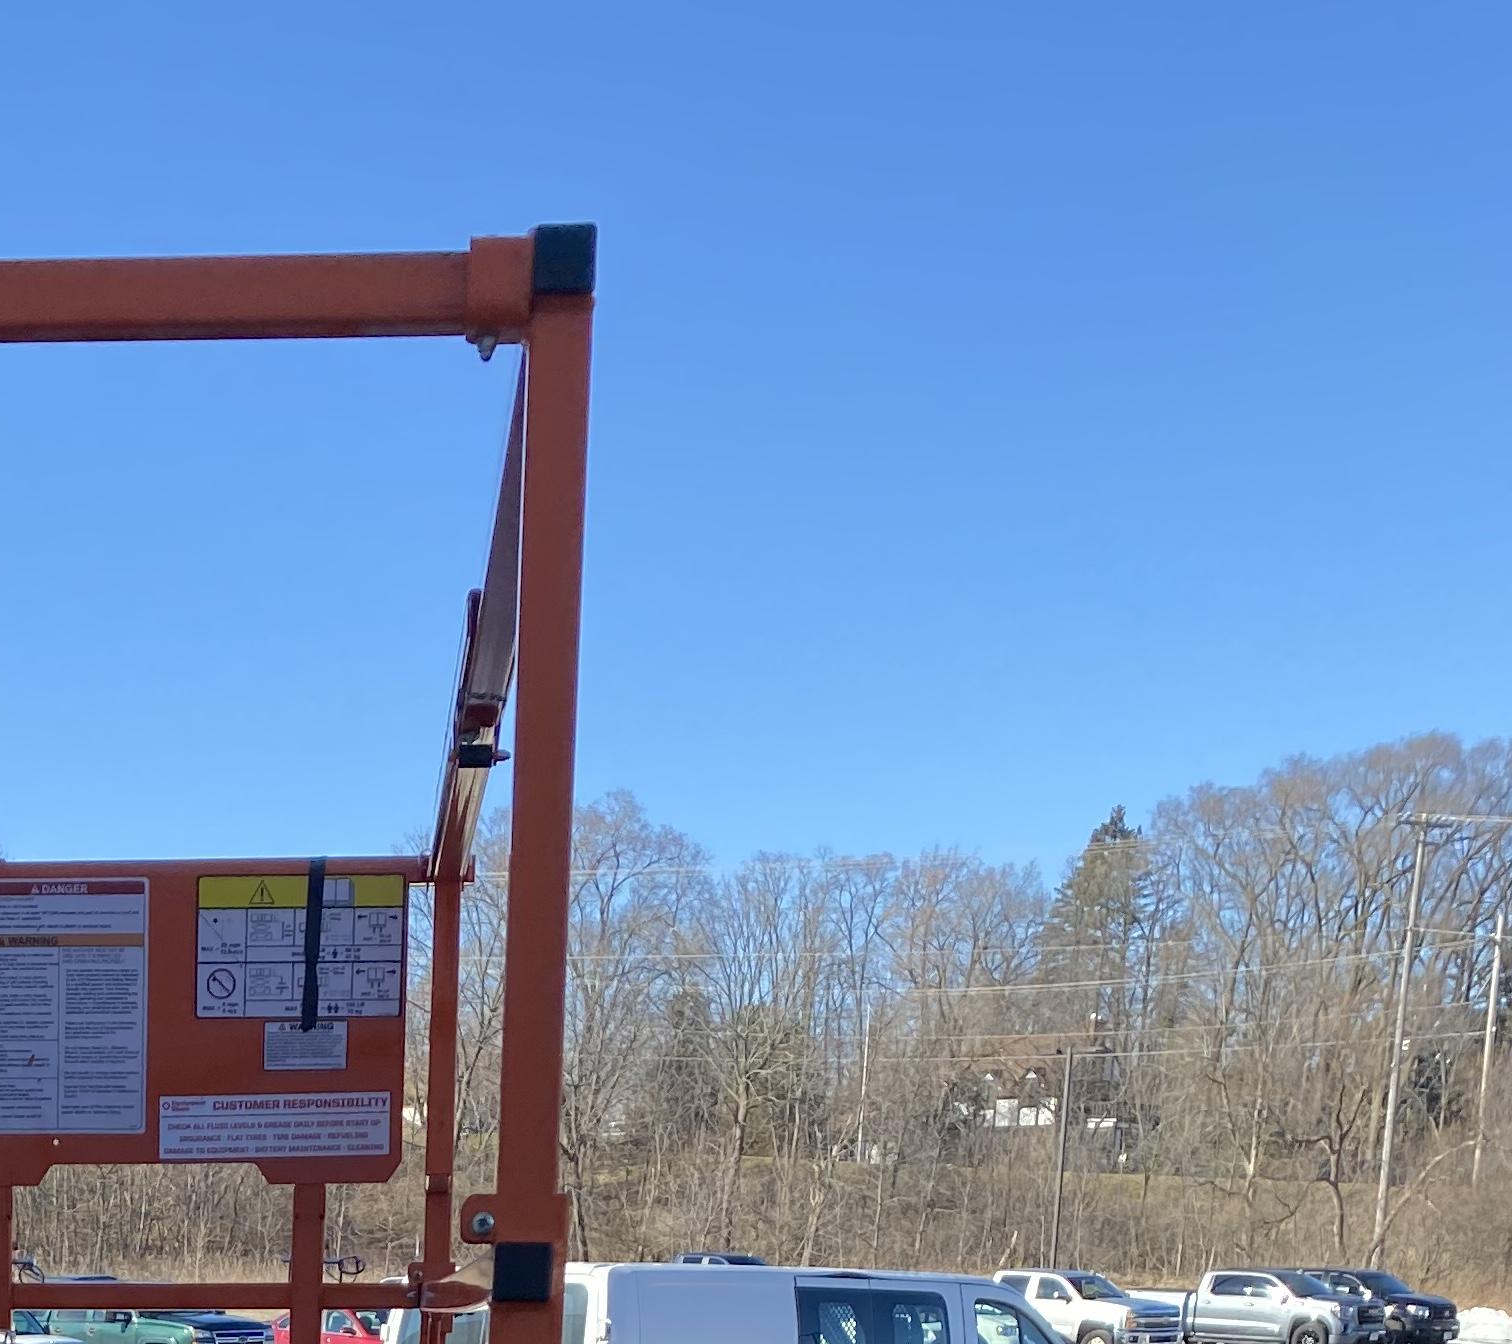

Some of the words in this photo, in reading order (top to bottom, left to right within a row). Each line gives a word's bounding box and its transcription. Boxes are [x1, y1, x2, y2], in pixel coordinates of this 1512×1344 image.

[41, 884, 88, 894] DANGER
[8, 936, 58, 946] WARNING
[212, 1100, 280, 1111] CUSTOMER
[283, 1096, 388, 1109] RESPONSIBILITY
